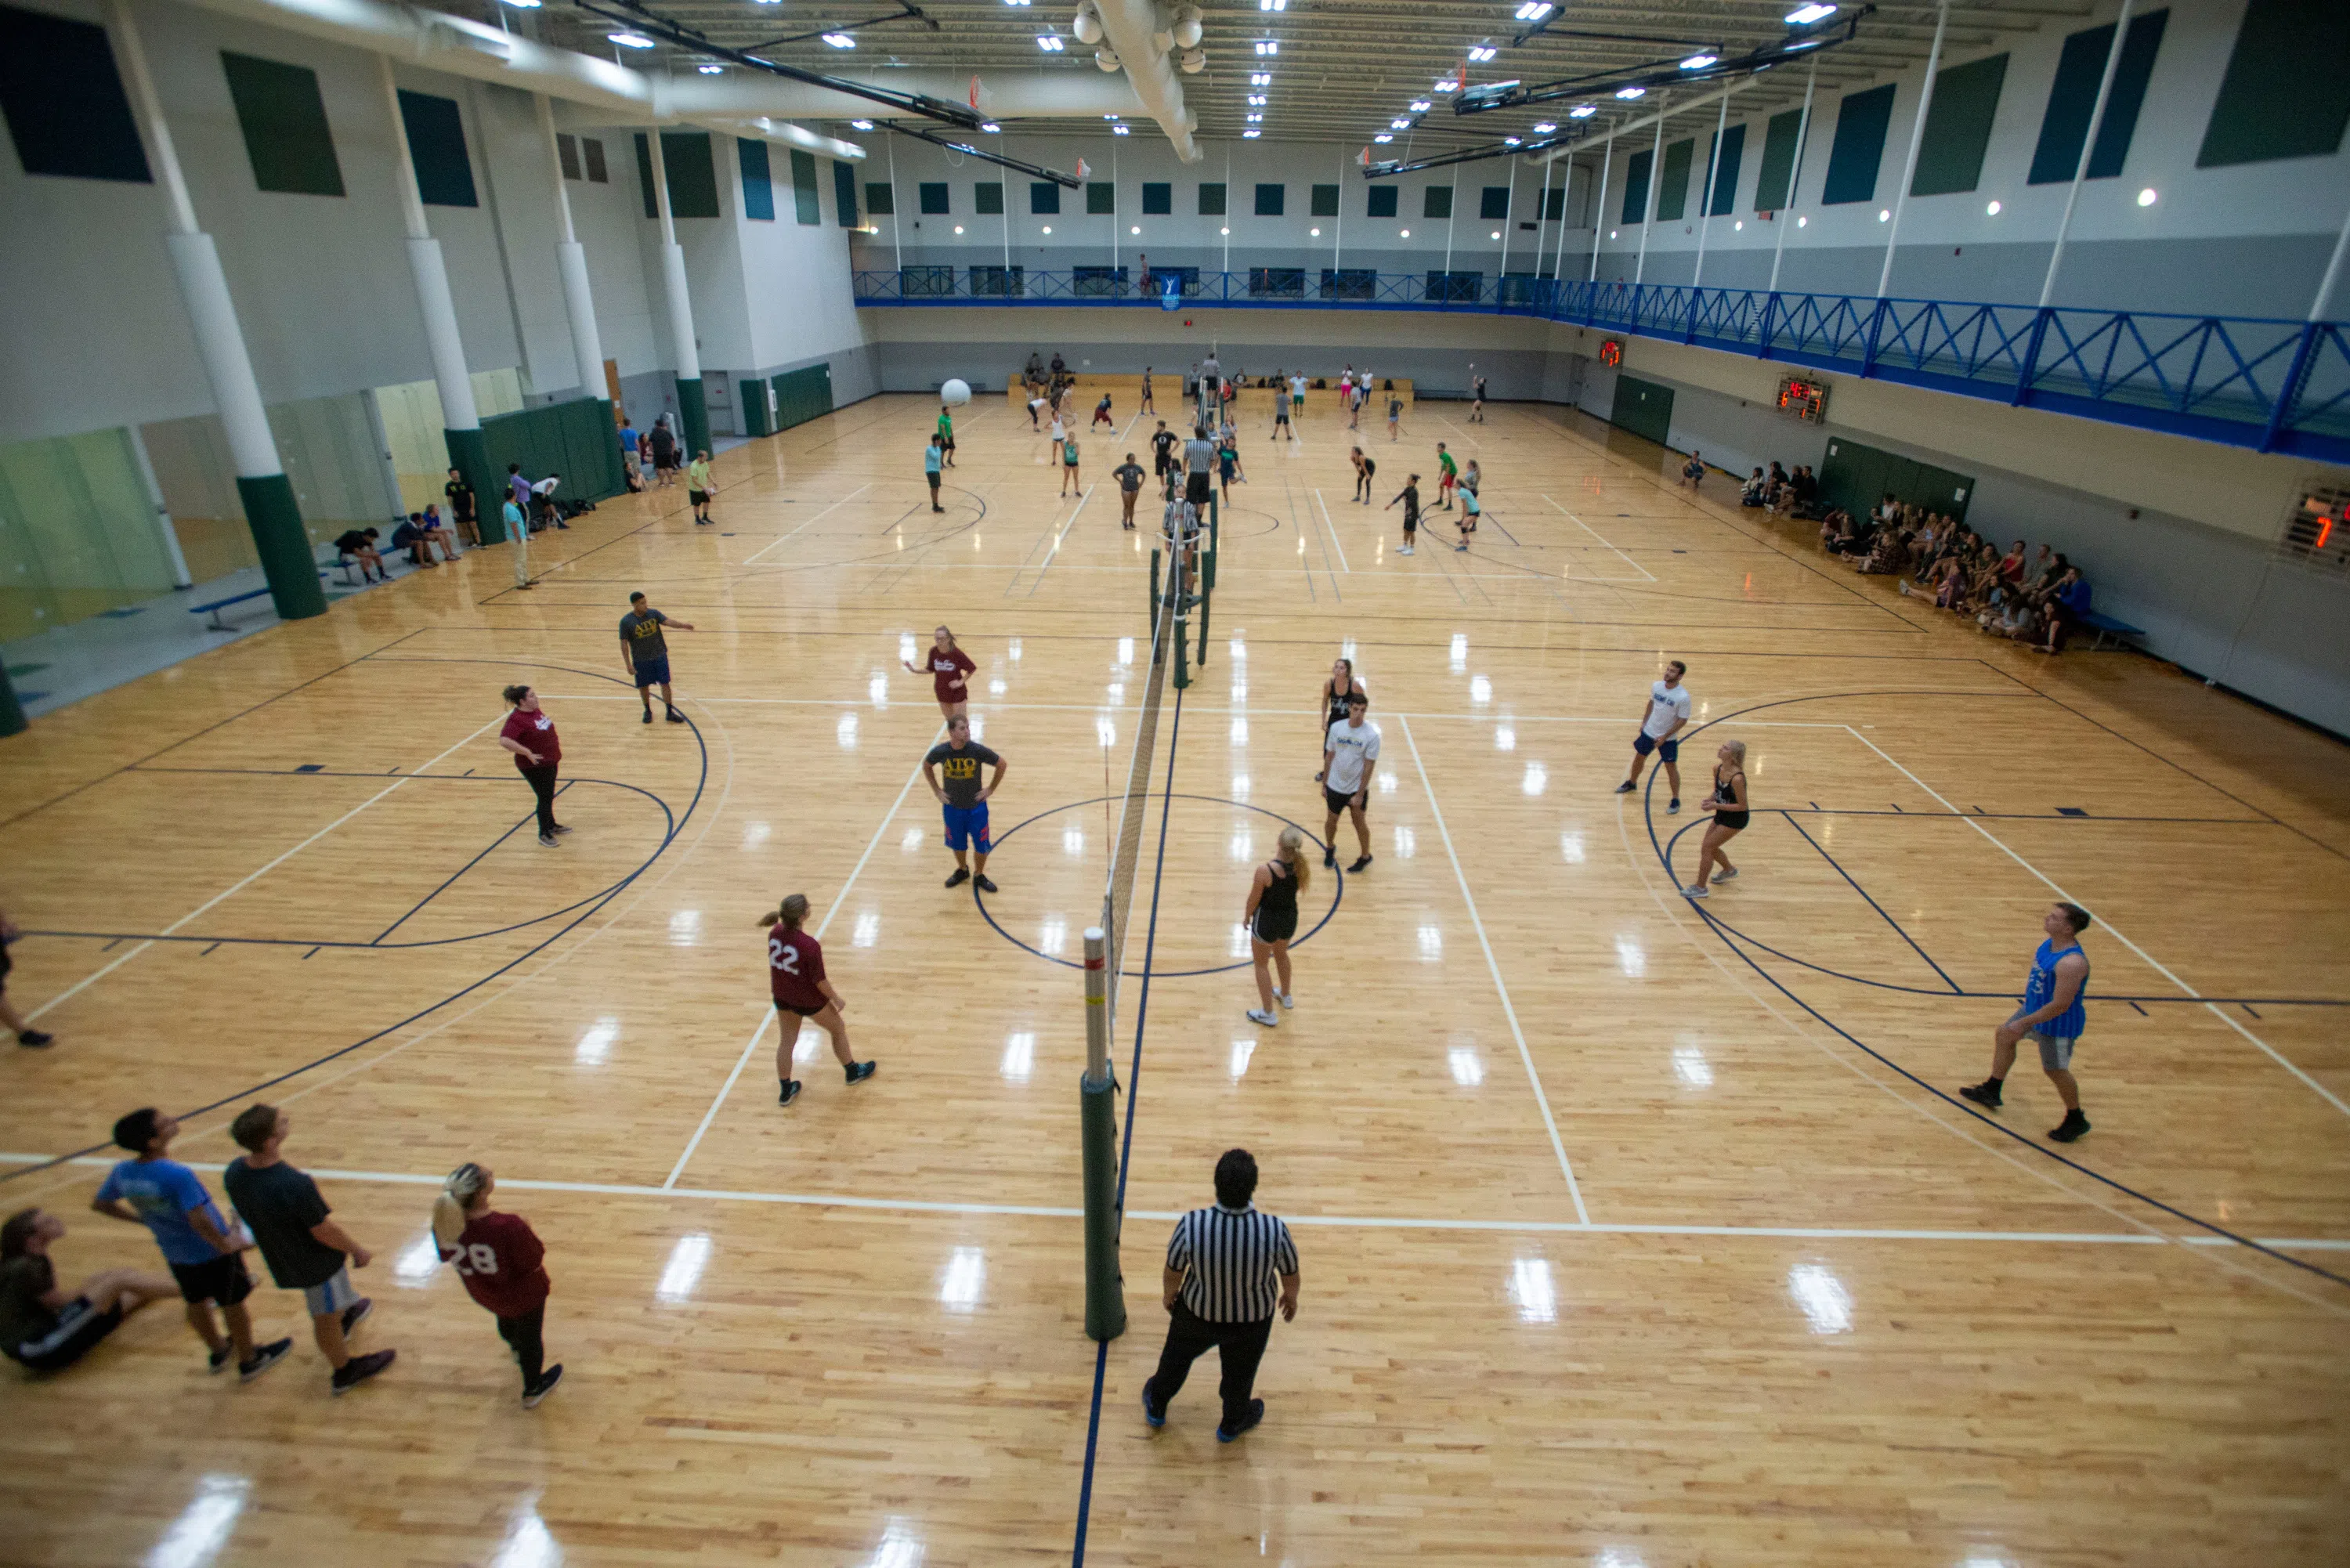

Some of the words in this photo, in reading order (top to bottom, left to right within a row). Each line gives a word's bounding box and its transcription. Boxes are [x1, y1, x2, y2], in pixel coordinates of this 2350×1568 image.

[2316, 517, 2332, 548] 7
[768, 938, 799, 975] 22
[442, 1243, 498, 1275] 28
